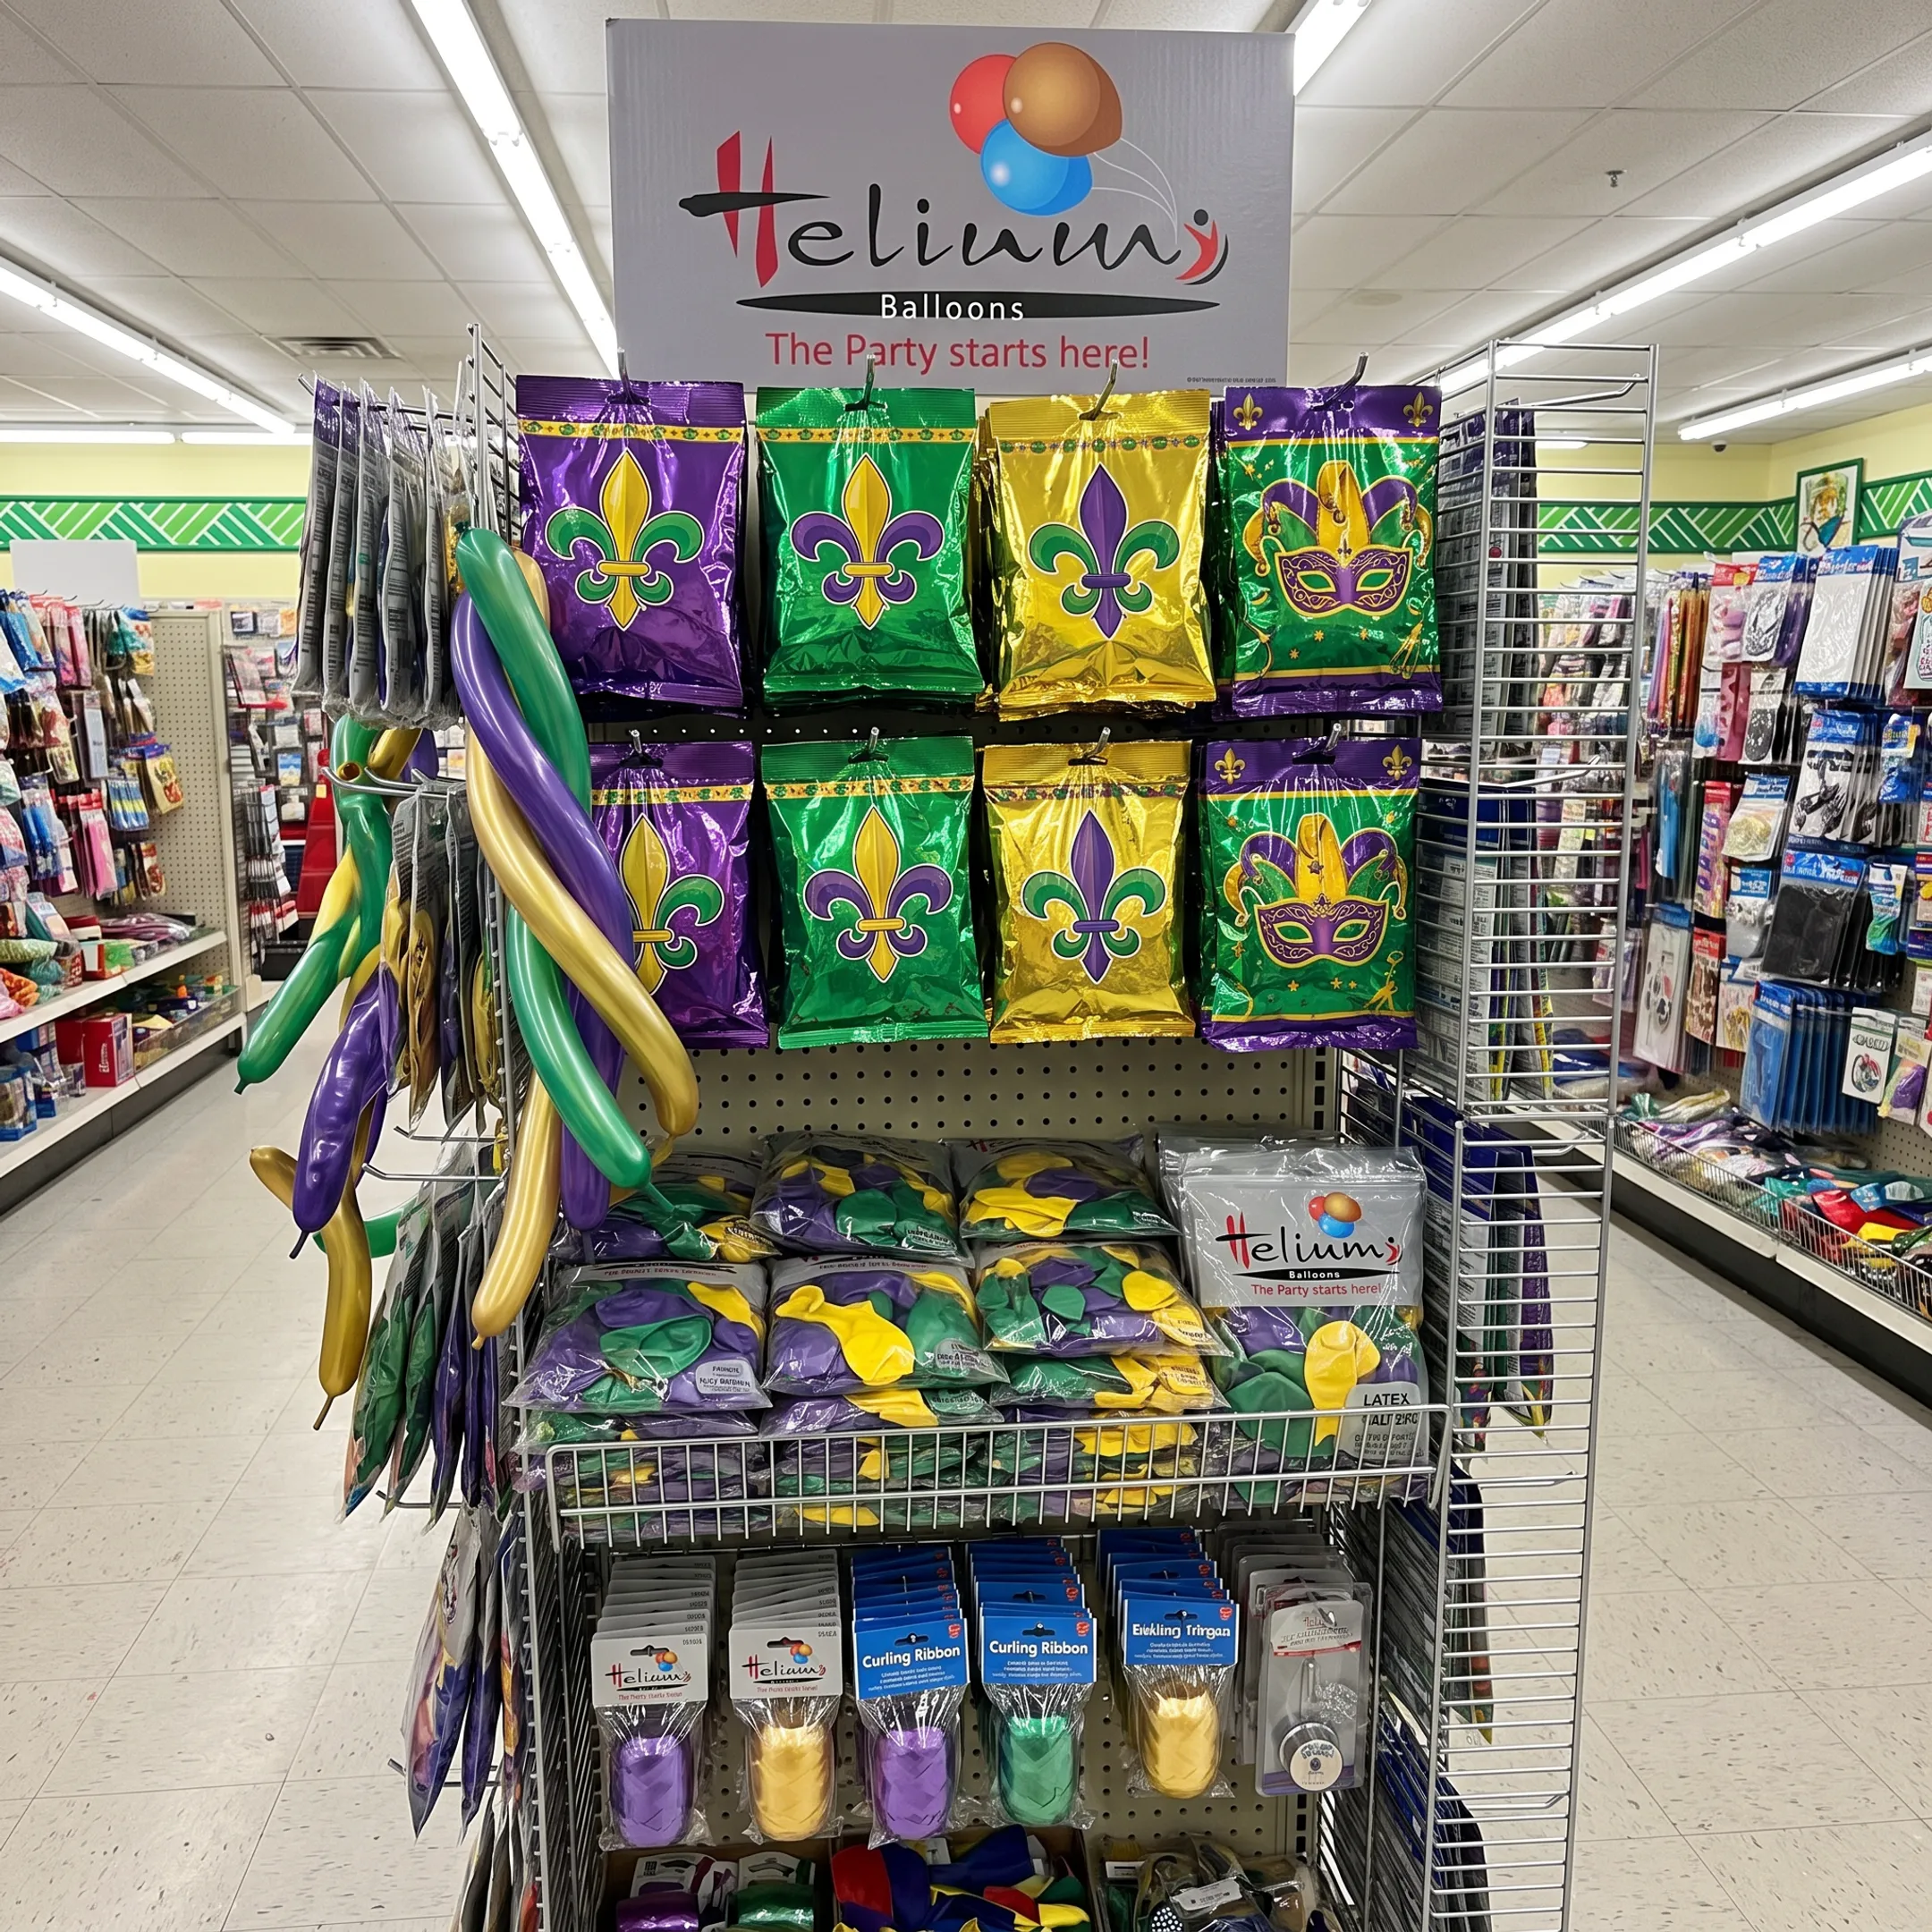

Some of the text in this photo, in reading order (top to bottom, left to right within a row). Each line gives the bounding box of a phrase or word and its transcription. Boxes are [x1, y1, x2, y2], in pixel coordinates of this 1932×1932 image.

[880, 293, 1024, 320] Balloons
[766, 333, 1148, 375] The Party starts here!
[1289, 1270, 1341, 1279] Balloons
[1251, 1284, 1274, 1295] The
[1277, 1284, 1309, 1297] Party
[1312, 1284, 1348, 1295] starts
[1364, 1393, 1411, 1406] LATEX
[862, 1645, 961, 1668] Curling Ribbon
[989, 1640, 1089, 1657] Curling Ribbon
